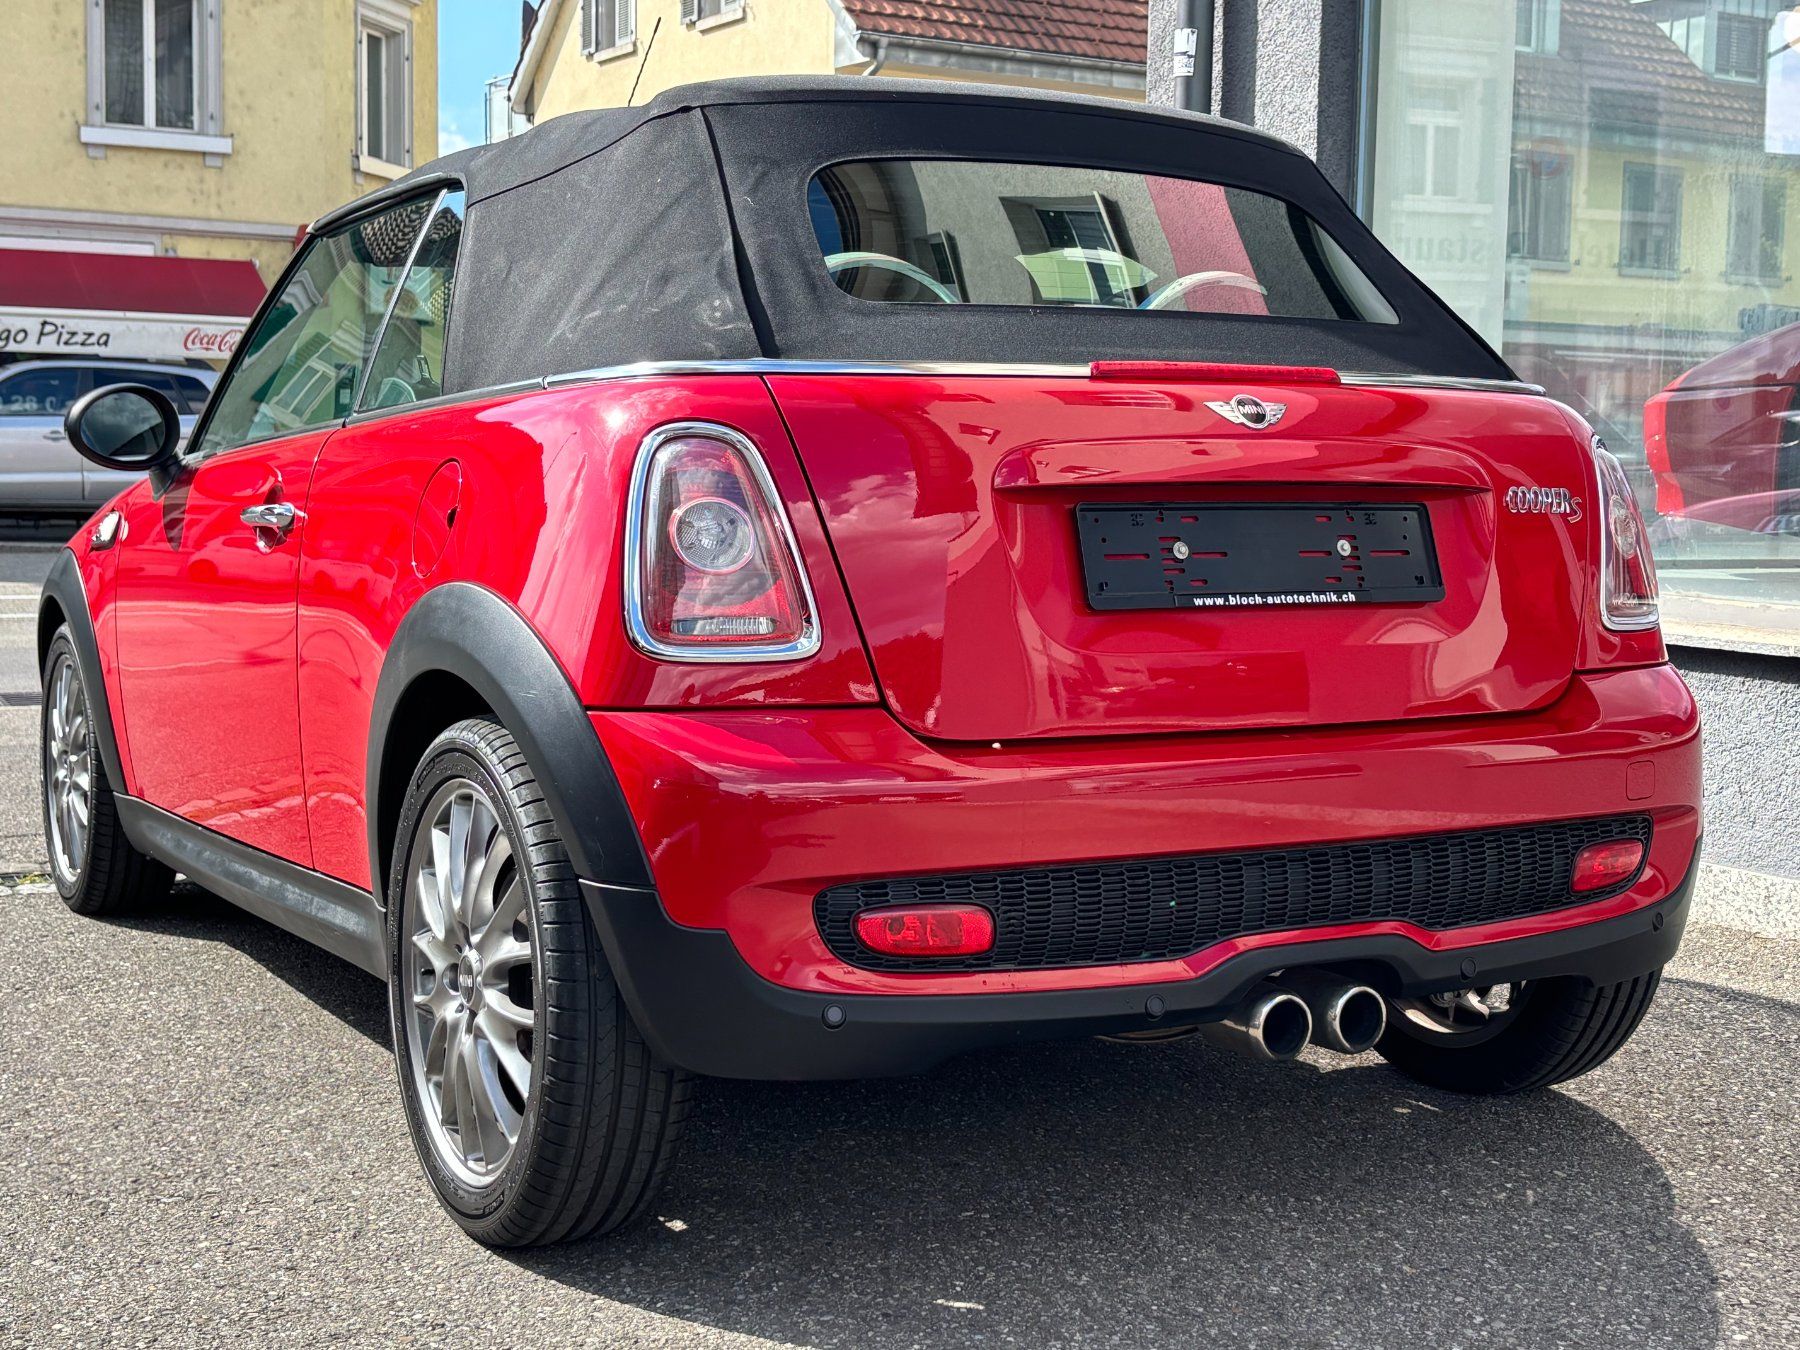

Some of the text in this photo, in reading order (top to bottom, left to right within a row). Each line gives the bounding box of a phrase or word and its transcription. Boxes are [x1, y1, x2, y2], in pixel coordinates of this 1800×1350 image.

[37, 319, 111, 348] Pizza
[1238, 404, 1266, 415] MINI
[1504, 486, 1583, 524] COOPER S
[1193, 591, 1356, 606] www.bloch-autotechnik.ch
